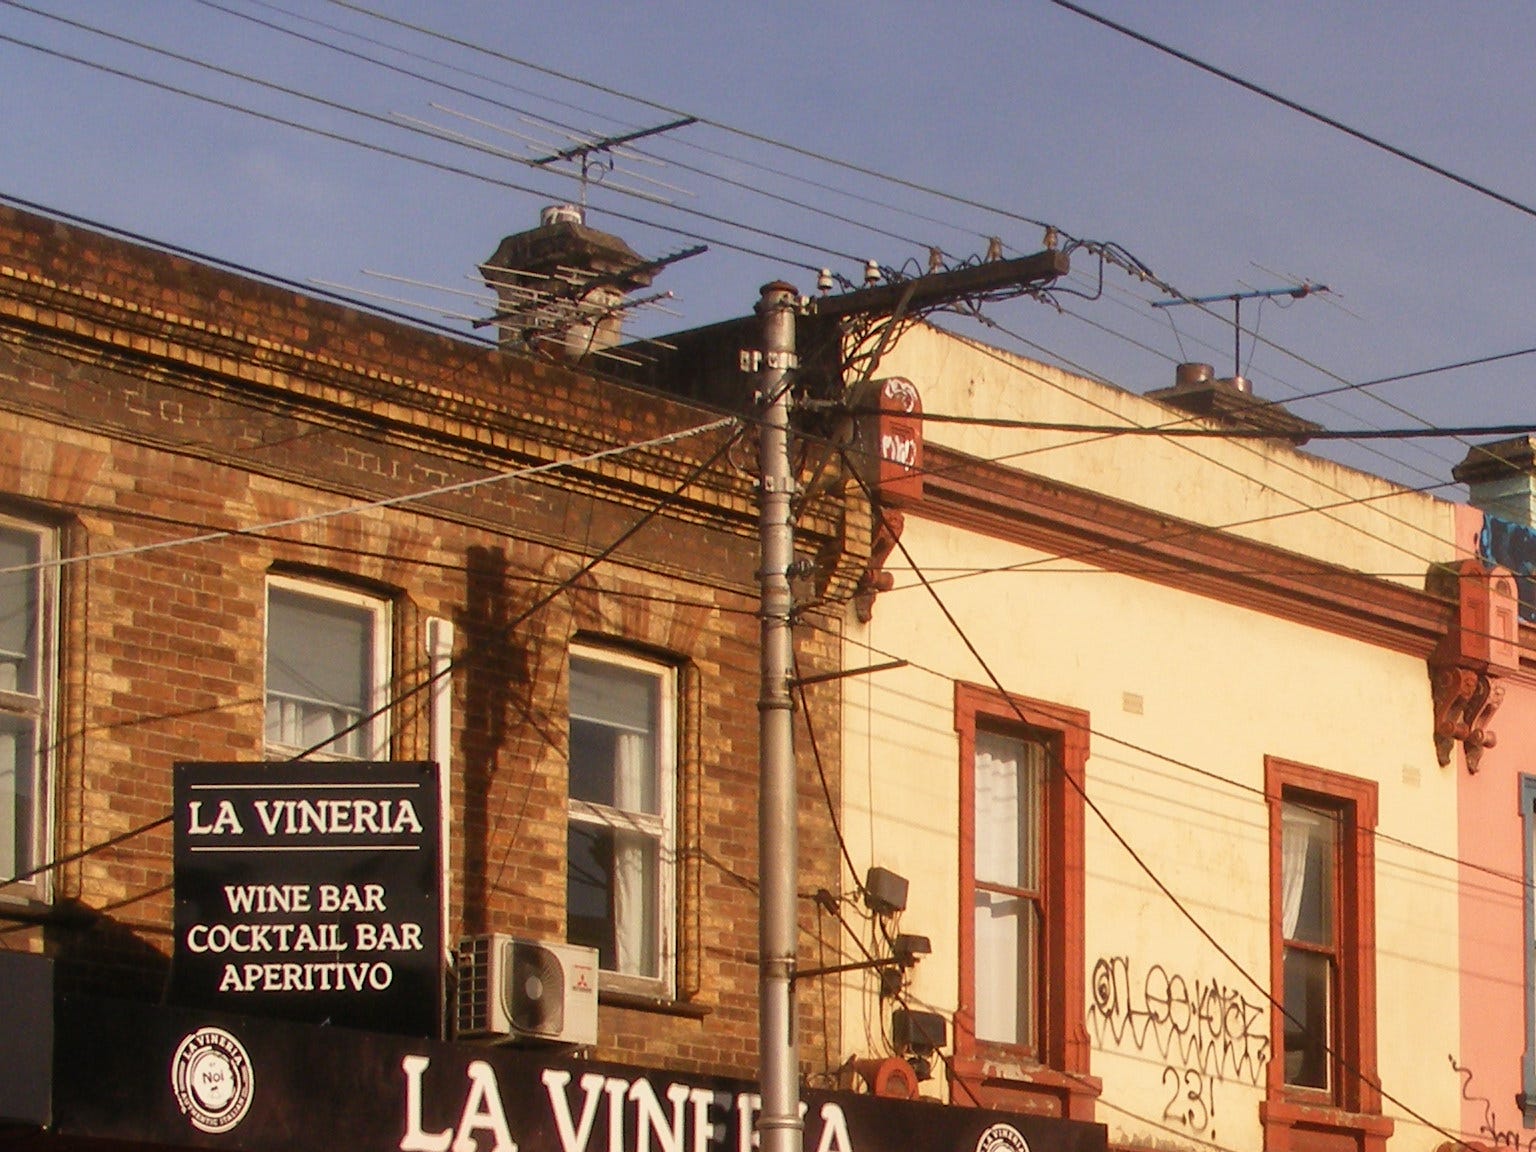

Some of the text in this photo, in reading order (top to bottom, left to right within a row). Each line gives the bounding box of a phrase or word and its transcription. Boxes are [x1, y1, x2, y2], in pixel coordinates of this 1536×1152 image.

[188, 799, 423, 835] LA VINERIA
[224, 884, 386, 913] WINE BAR
[187, 923, 423, 952] COCKTAIL BAR
[219, 962, 393, 991] APERITIVO
[196, 1034, 243, 1067] VINERIA
